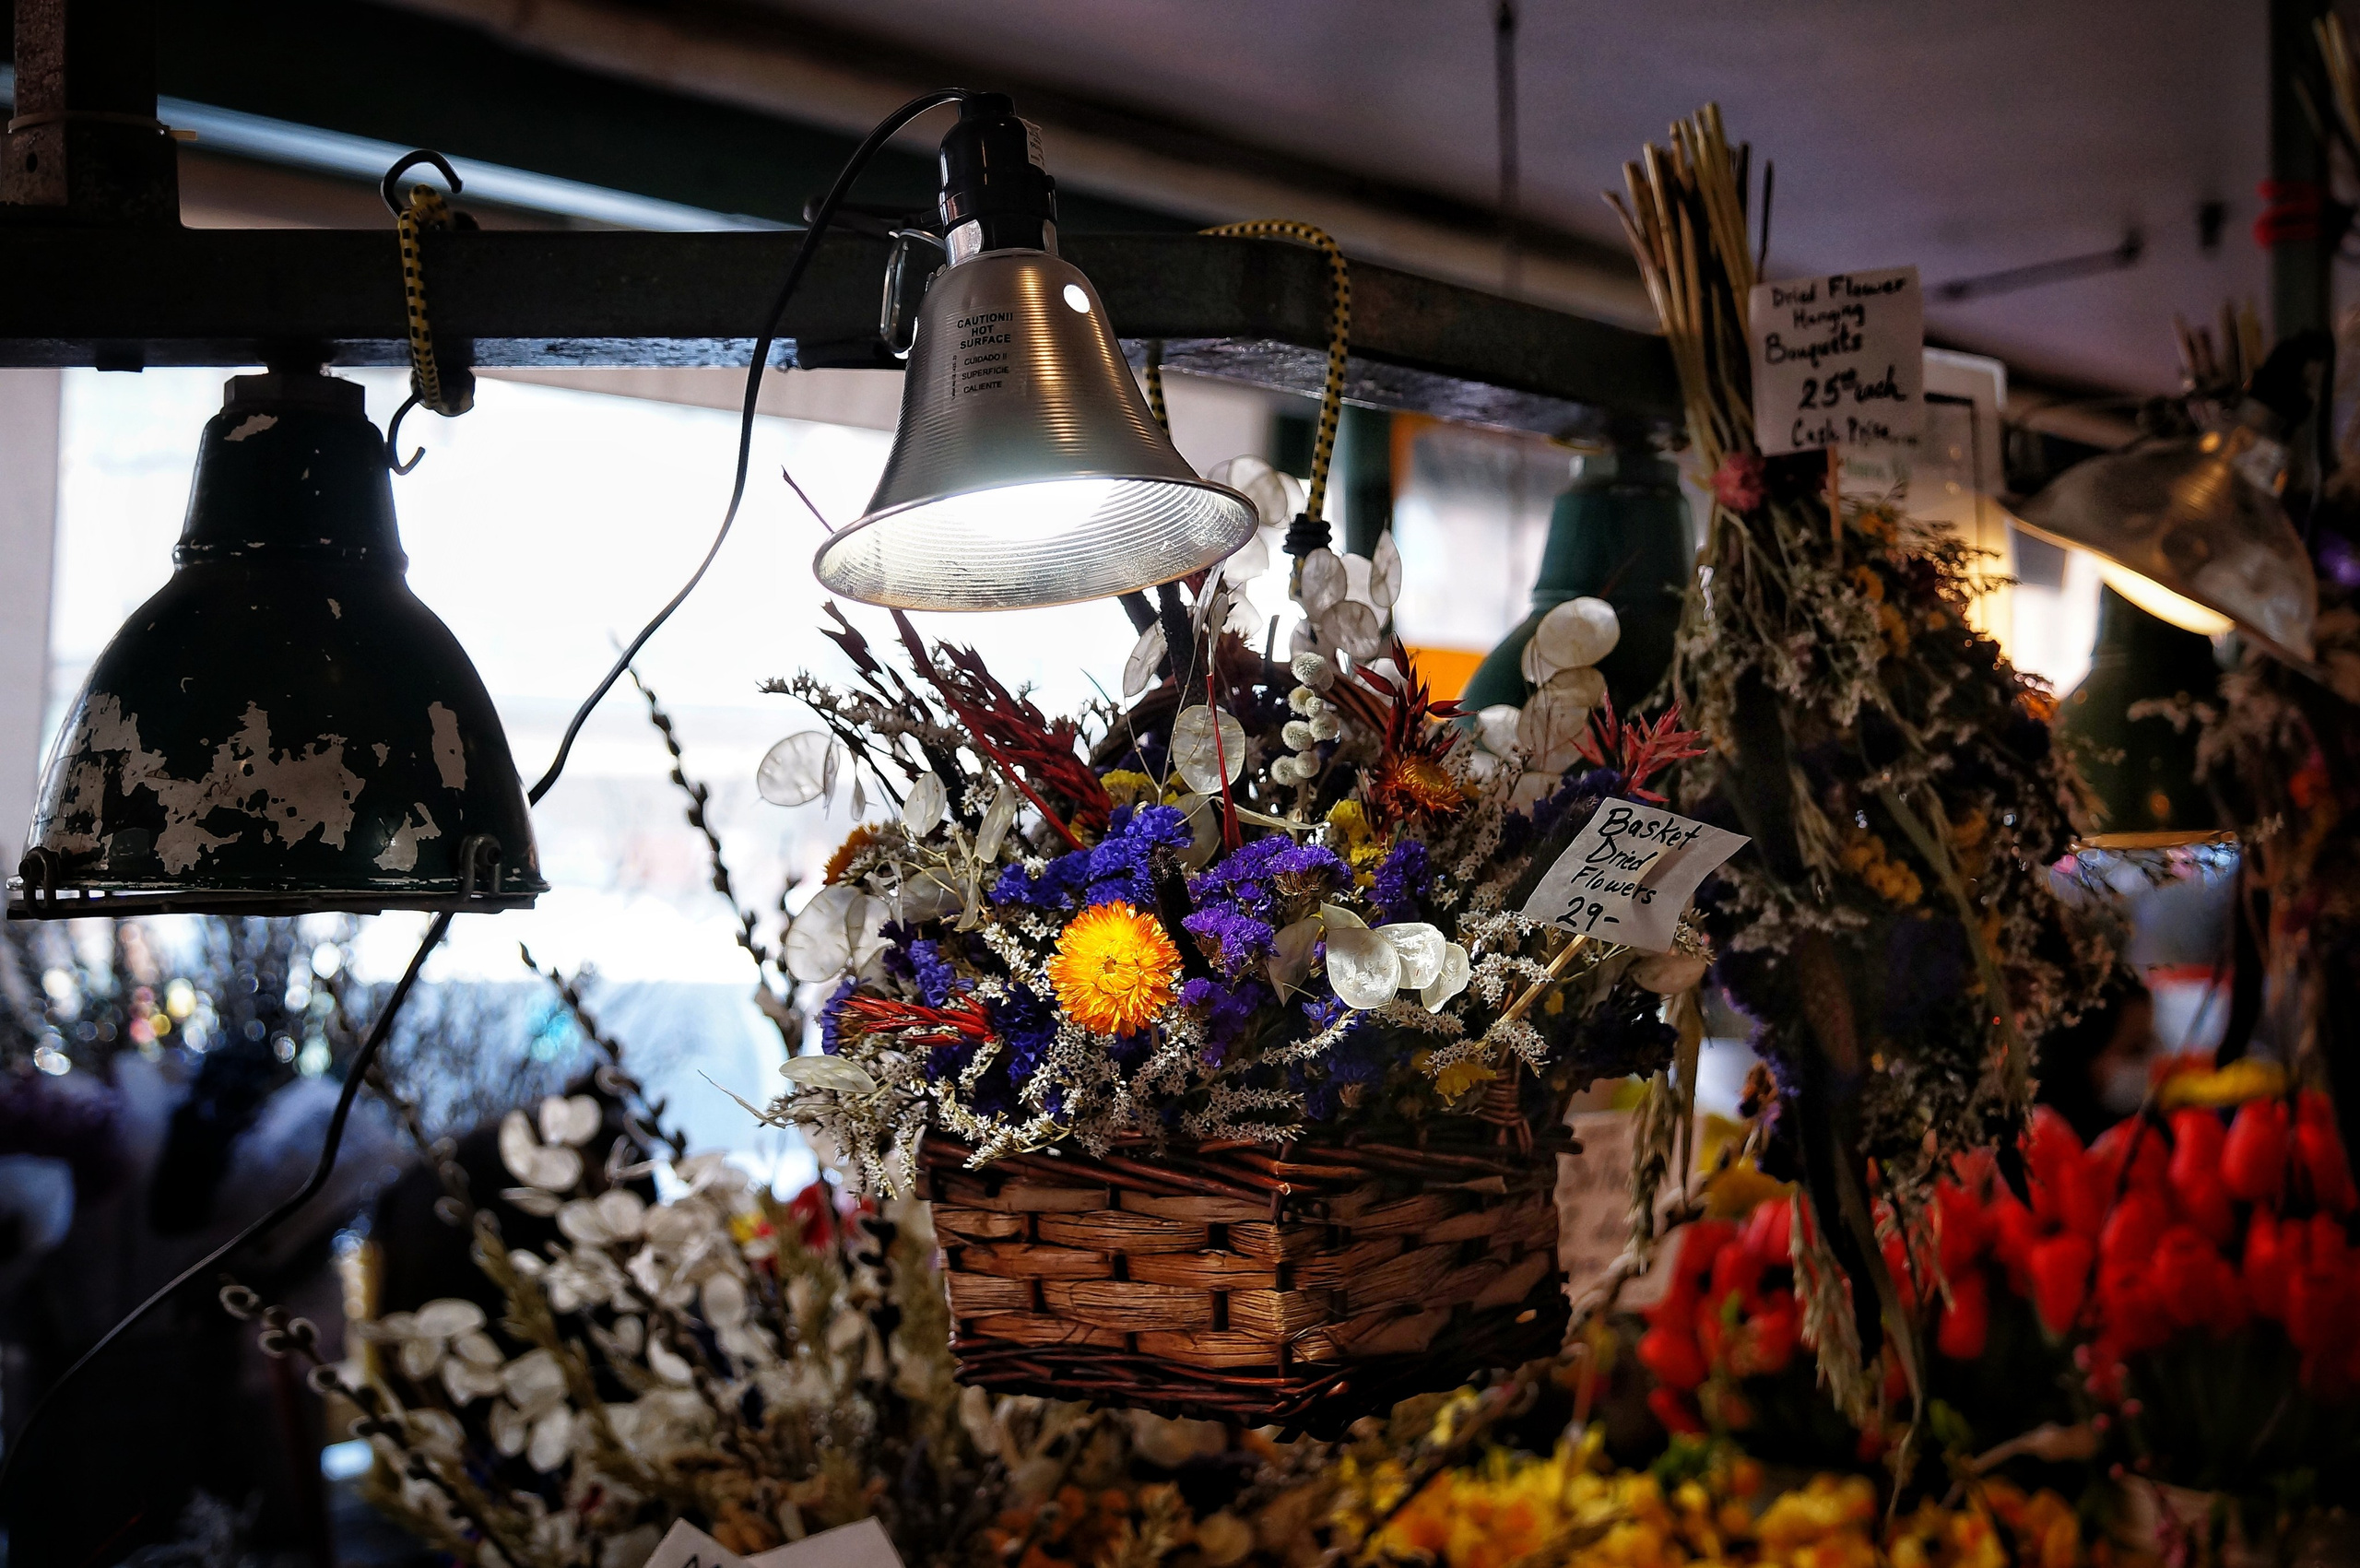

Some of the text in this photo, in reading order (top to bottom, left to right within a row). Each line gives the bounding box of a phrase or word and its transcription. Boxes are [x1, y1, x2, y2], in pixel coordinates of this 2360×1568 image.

[1829, 275, 1906, 299] Flower
[1793, 303, 1865, 332] Hanging
[971, 324, 994, 336] HOT
[960, 334, 1011, 349] SURFACE
[964, 354, 1000, 366] CUIDADO
[962, 366, 1009, 381] SUPERFICIE
[963, 381, 1002, 394] CALIENTE
[1598, 808, 1703, 851] Basket
[1586, 835, 1658, 871] Dried
[1570, 867, 1658, 904] Flowers
